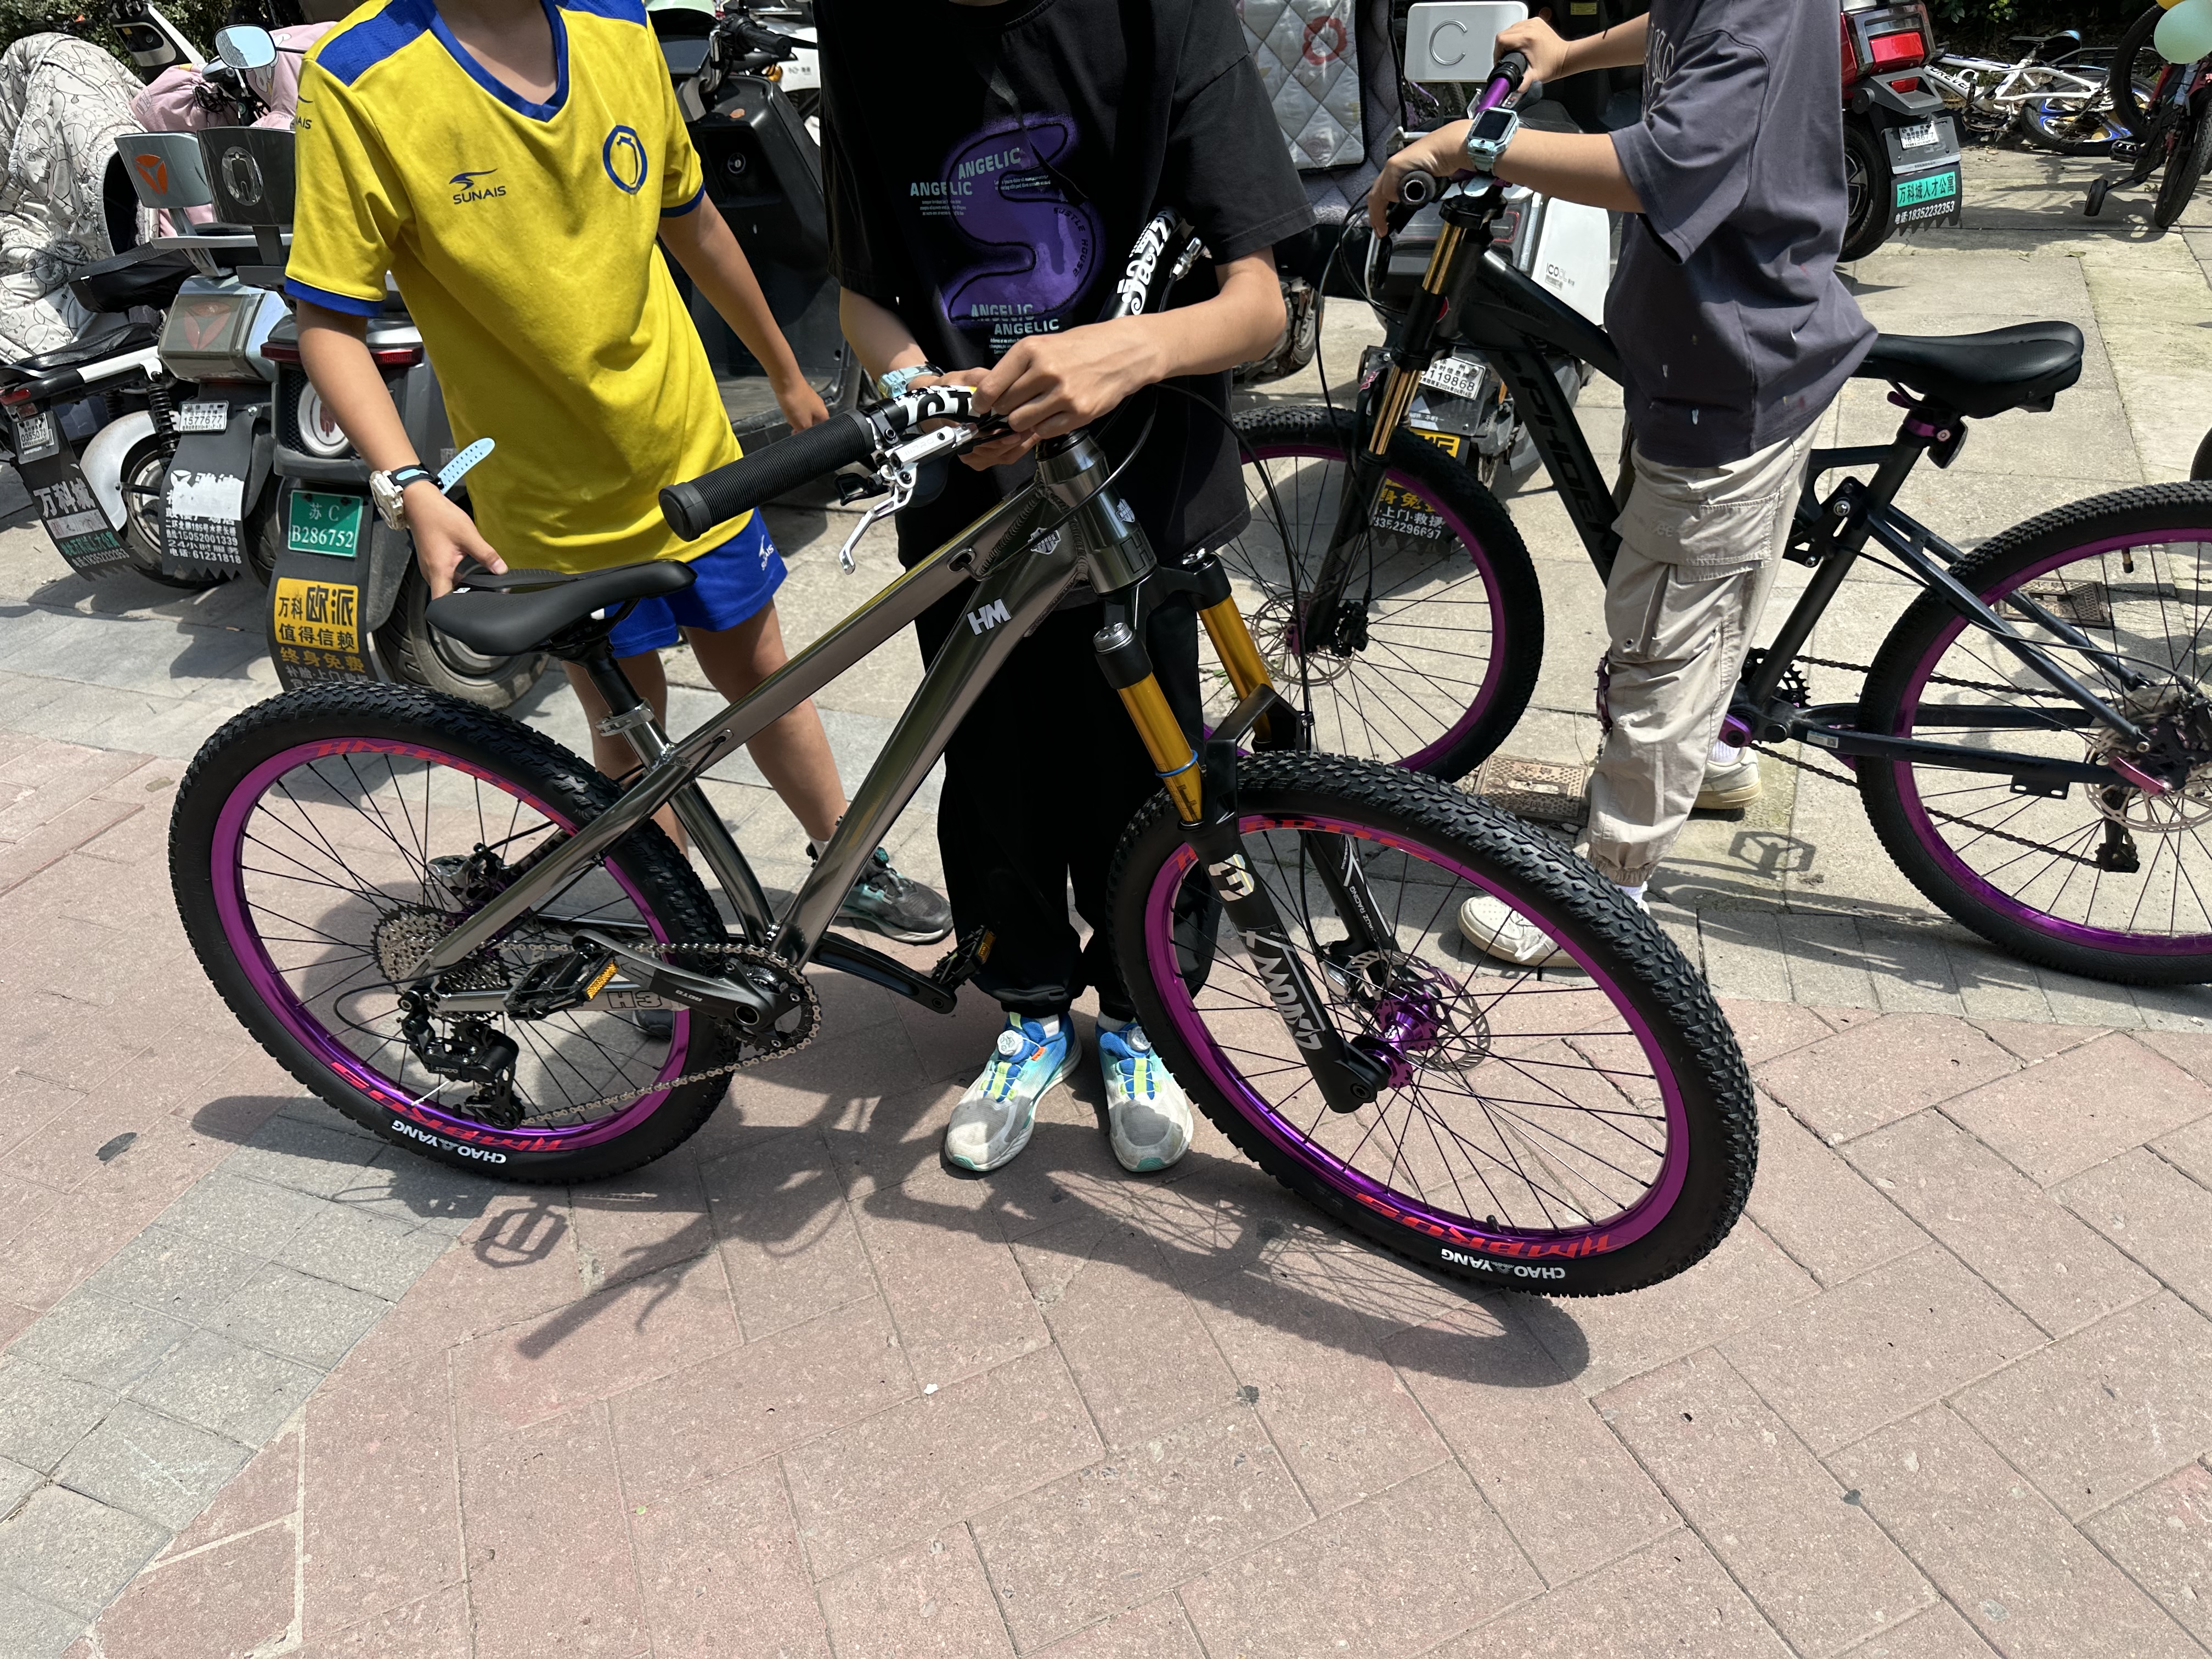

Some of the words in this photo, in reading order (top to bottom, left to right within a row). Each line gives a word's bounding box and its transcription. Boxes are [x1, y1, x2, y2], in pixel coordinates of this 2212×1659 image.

[958, 147, 1021, 179] ANGELIC
[453, 185, 507, 205] SUNAIS
[910, 182, 973, 197] ANGELIC
[970, 303, 1035, 322] ANGELIC
[994, 319, 1059, 335] ANGELIC
[184, 415, 223, 426] 1577677
[291, 524, 354, 549] B286752
[279, 623, 356, 651] 值得信赖
[280, 646, 366, 674] 终身免费
[392, 1119, 441, 1148] YANG
[458, 1146, 506, 1164] CHAO
[1442, 1248, 1493, 1272] YANG
[1515, 1265, 1566, 1280] CHAO
